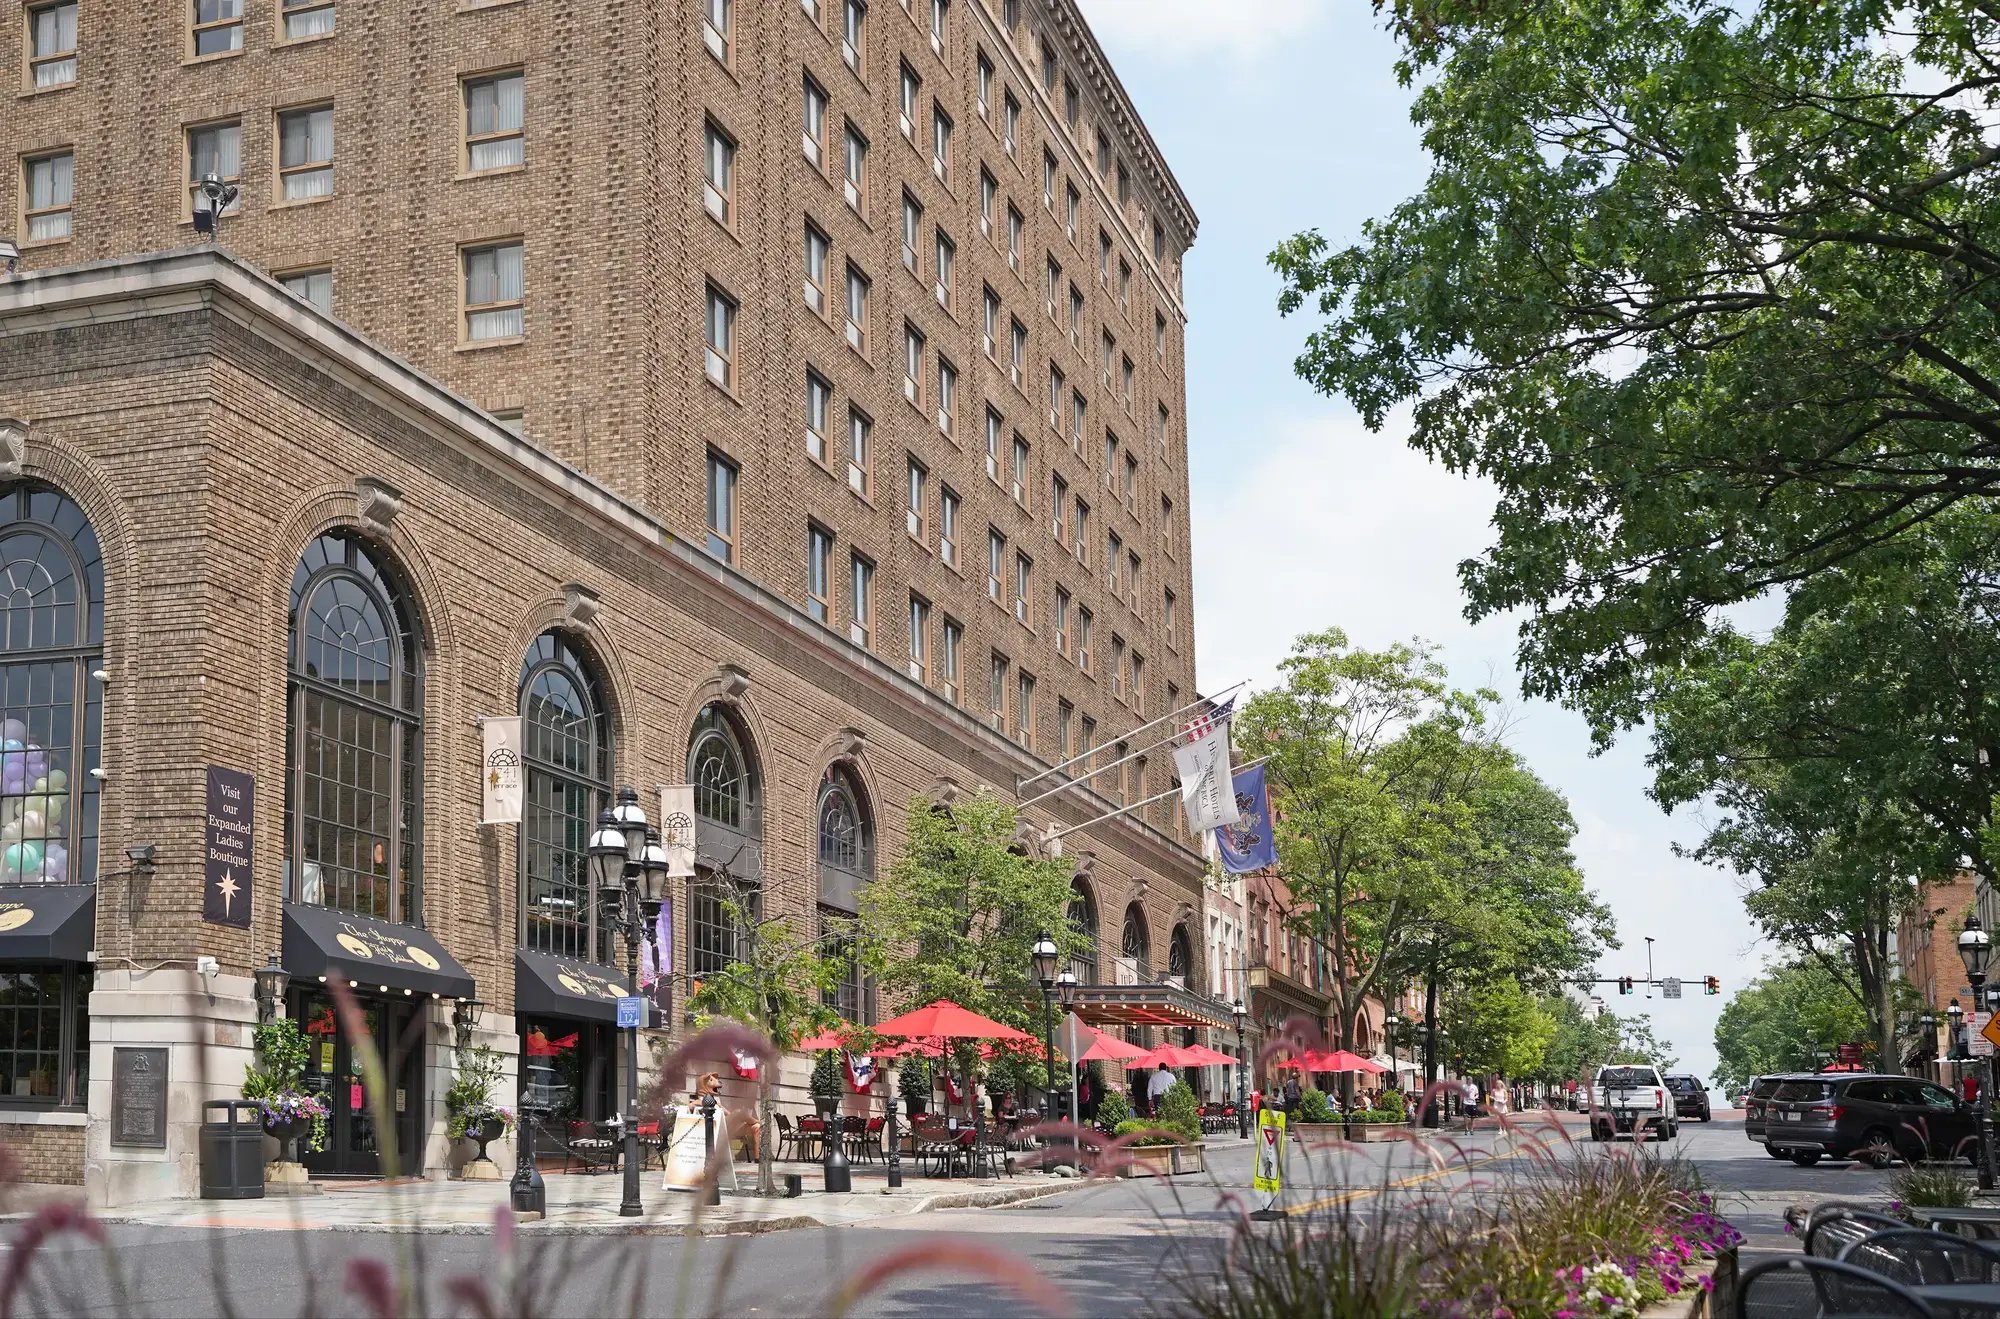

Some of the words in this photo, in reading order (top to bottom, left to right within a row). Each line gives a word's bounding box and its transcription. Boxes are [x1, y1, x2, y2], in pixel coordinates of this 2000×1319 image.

[221, 784, 240, 799] Visit
[223, 804, 238, 815] our
[1209, 786, 1221, 820] HOTELS
[208, 814, 251, 835] Expanded
[215, 832, 243, 849] Ladies
[209, 847, 249, 867] Boutique
[339, 921, 369, 939] The
[367, 927, 407, 947] Shoppe
[625, 1013, 633, 1023] 12
